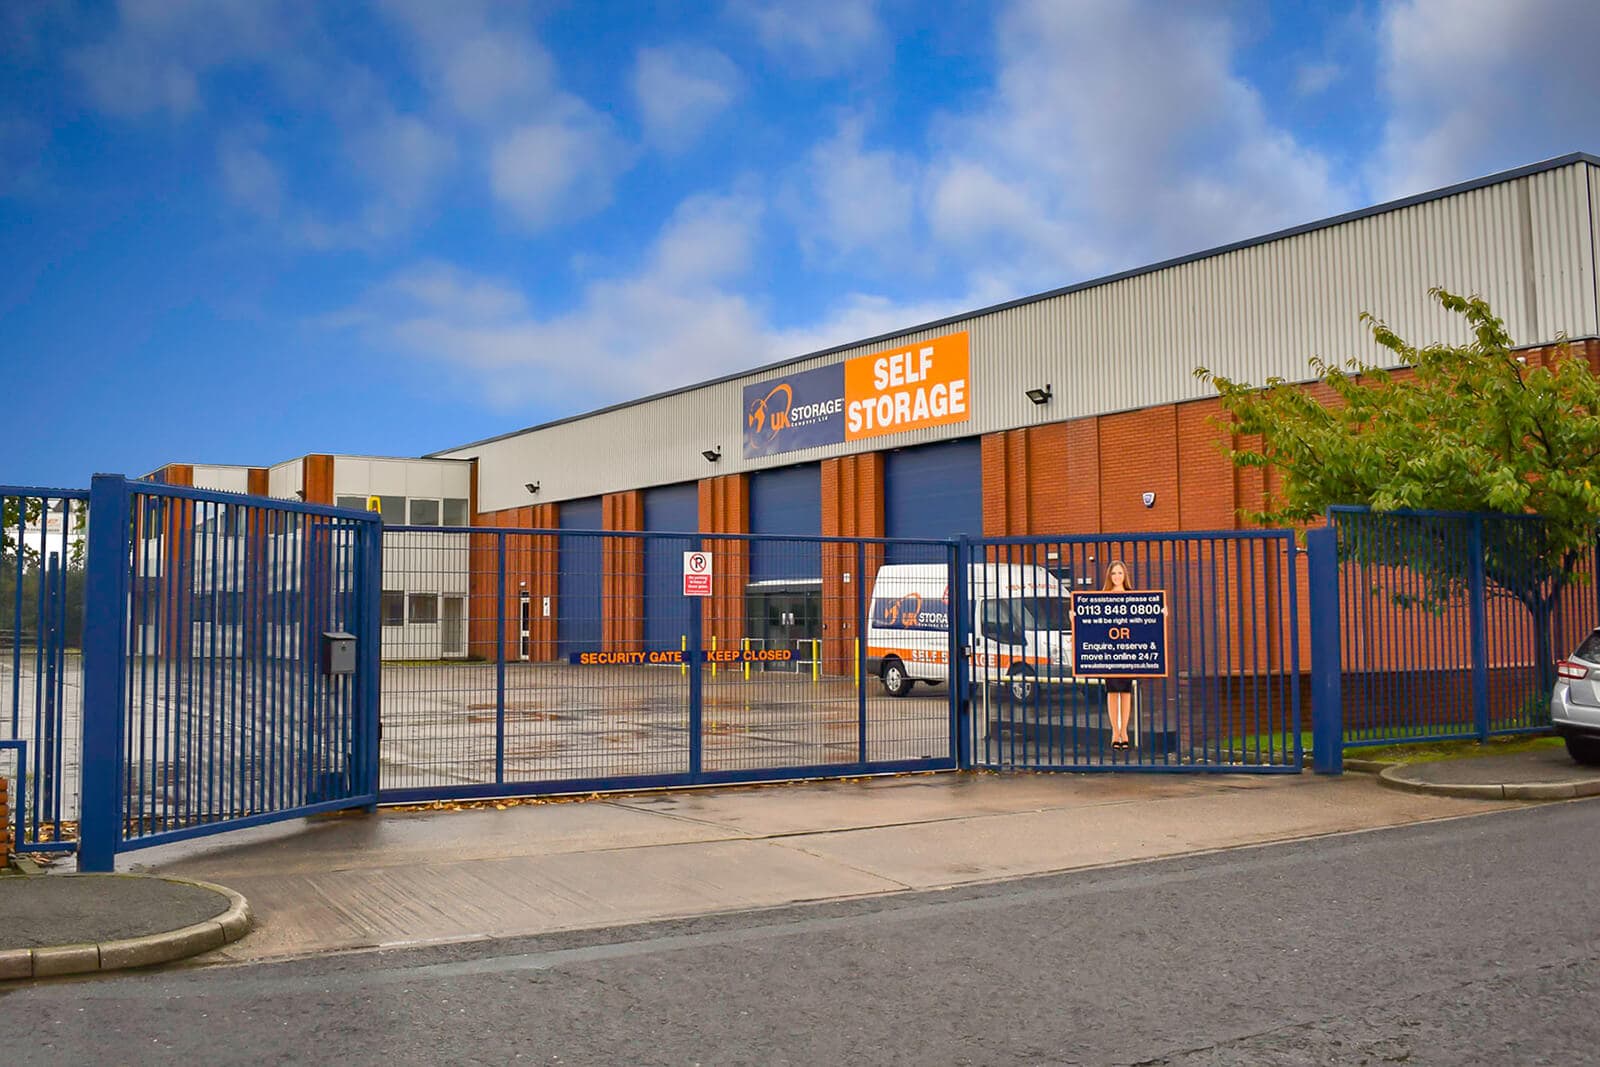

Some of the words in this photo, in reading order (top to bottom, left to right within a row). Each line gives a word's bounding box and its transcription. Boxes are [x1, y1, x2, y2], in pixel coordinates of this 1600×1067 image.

[874, 347, 934, 391] SELF
[848, 379, 965, 433] STORAGE
[771, 411, 791, 431] UK
[791, 399, 842, 422] STORAGE
[1077, 605, 1101, 616] 0113
[1104, 604, 1127, 615] 848
[1130, 604, 1160, 615] 0800
[919, 612, 949, 624] STORA
[1113, 617, 1128, 625] right
[1108, 627, 1130, 640] OR
[1082, 642, 1115, 652] Enquire,
[1150, 642, 1157, 650] &
[580, 652, 647, 664] SECURITY
[649, 651, 682, 663] GATE
[707, 650, 739, 661] KEEP
[743, 650, 791, 661] CLOSED
[1113, 652, 1137, 660] online
[1138, 652, 1159, 660] 24/7
